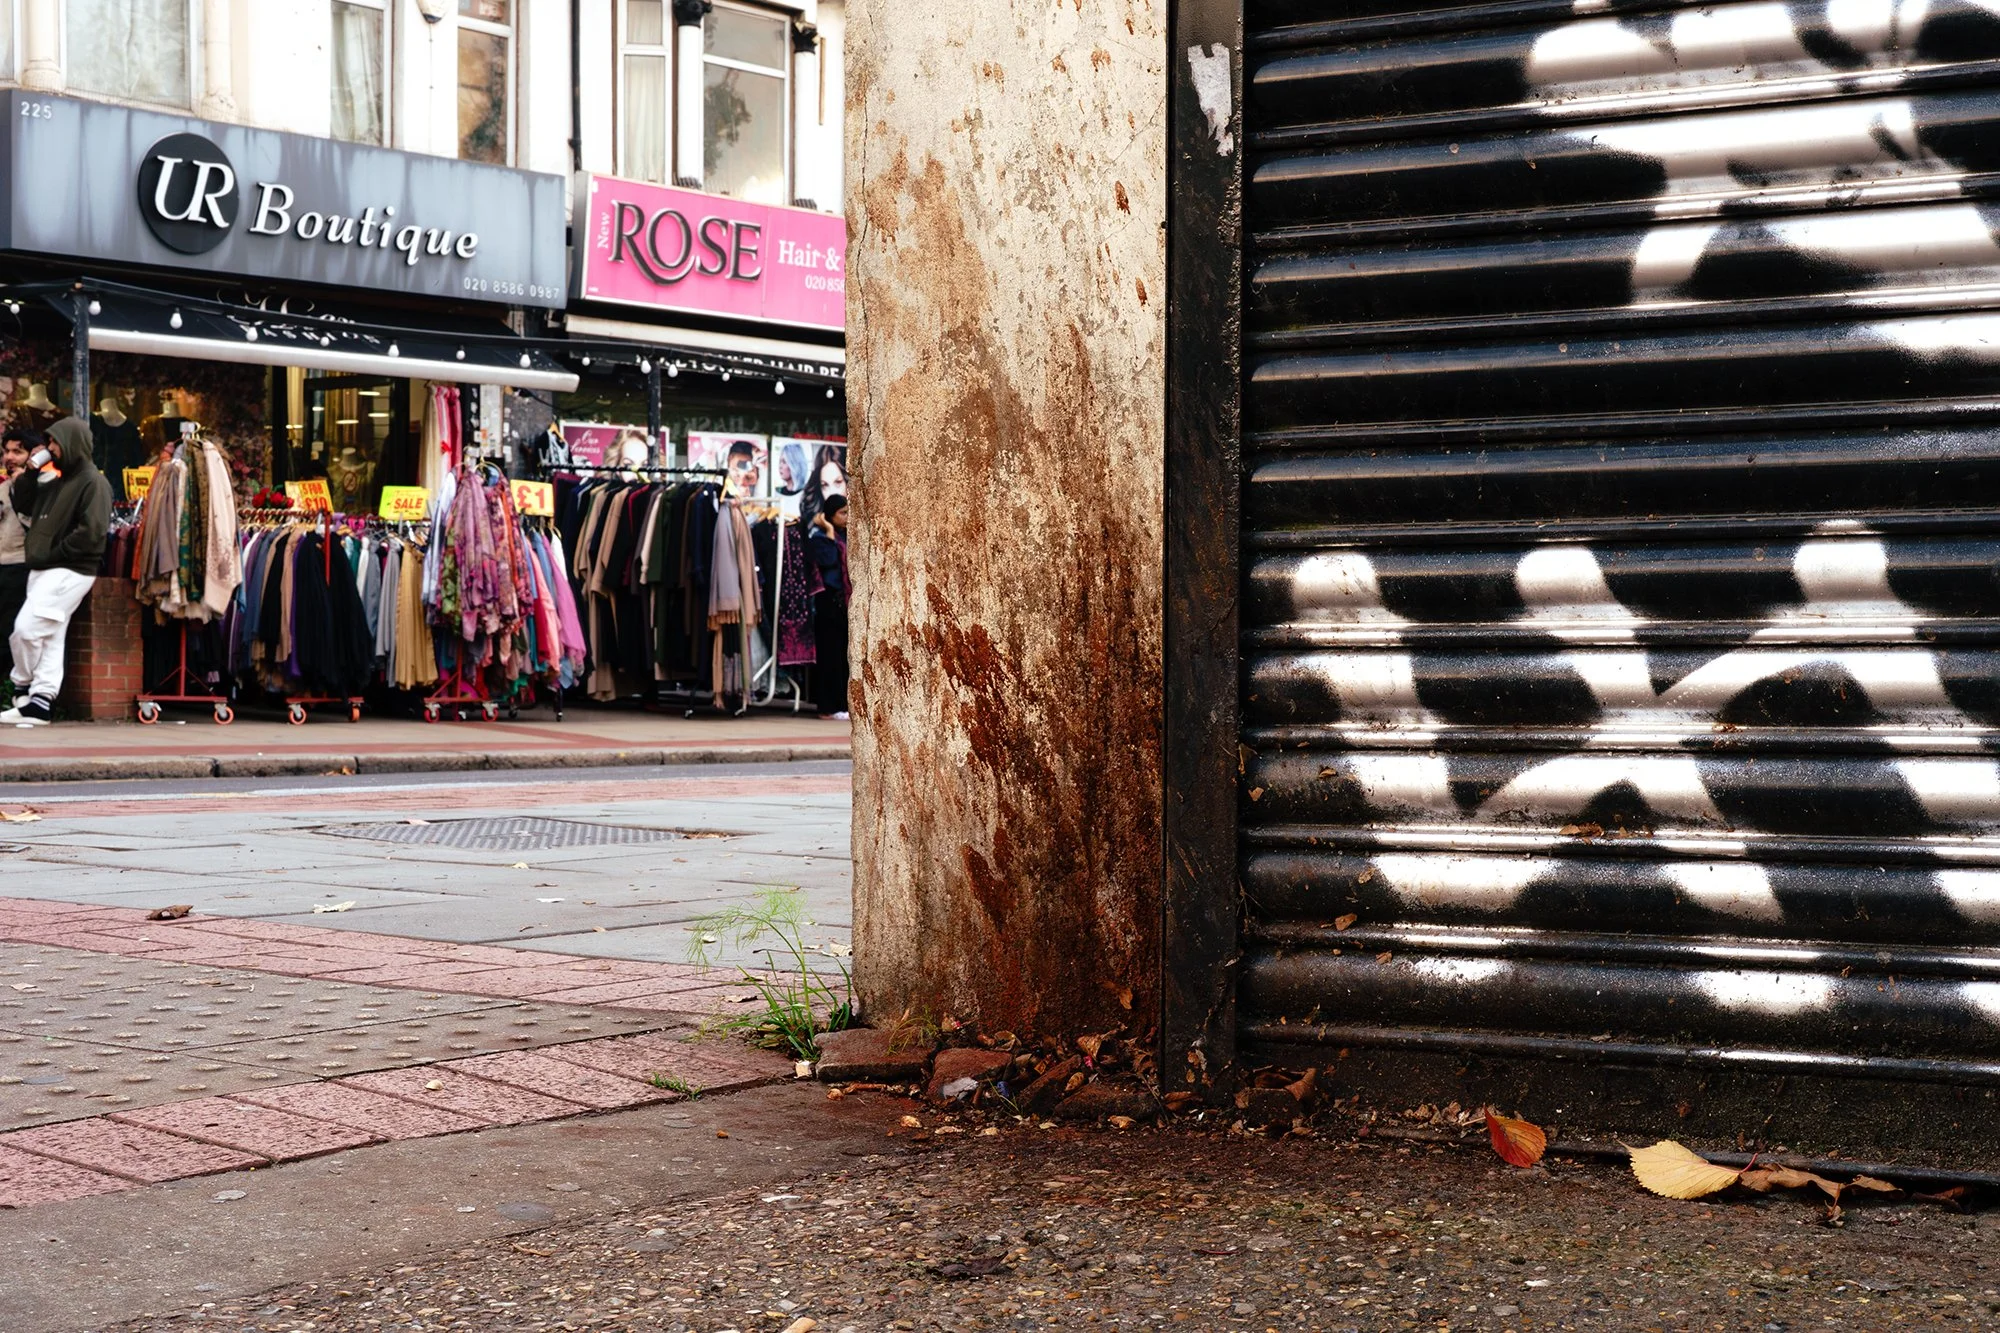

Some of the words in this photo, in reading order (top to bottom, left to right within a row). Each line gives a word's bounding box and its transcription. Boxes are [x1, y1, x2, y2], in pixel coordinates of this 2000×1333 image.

[20, 100, 53, 120] 225
[154, 155, 235, 229] UR
[250, 181, 480, 266] Boutique
[597, 211, 610, 249] New
[608, 199, 762, 286] ROSE
[778, 239, 821, 268] Hair
[825, 247, 841, 272] &
[463, 277, 488, 292] 020
[493, 280, 525, 296] 8586
[805, 274, 826, 290] 020
[309, 483, 323, 494] FOR
[517, 485, 545, 509] £1
[305, 497, 328, 513] £10
[393, 497, 423, 510] SALE
